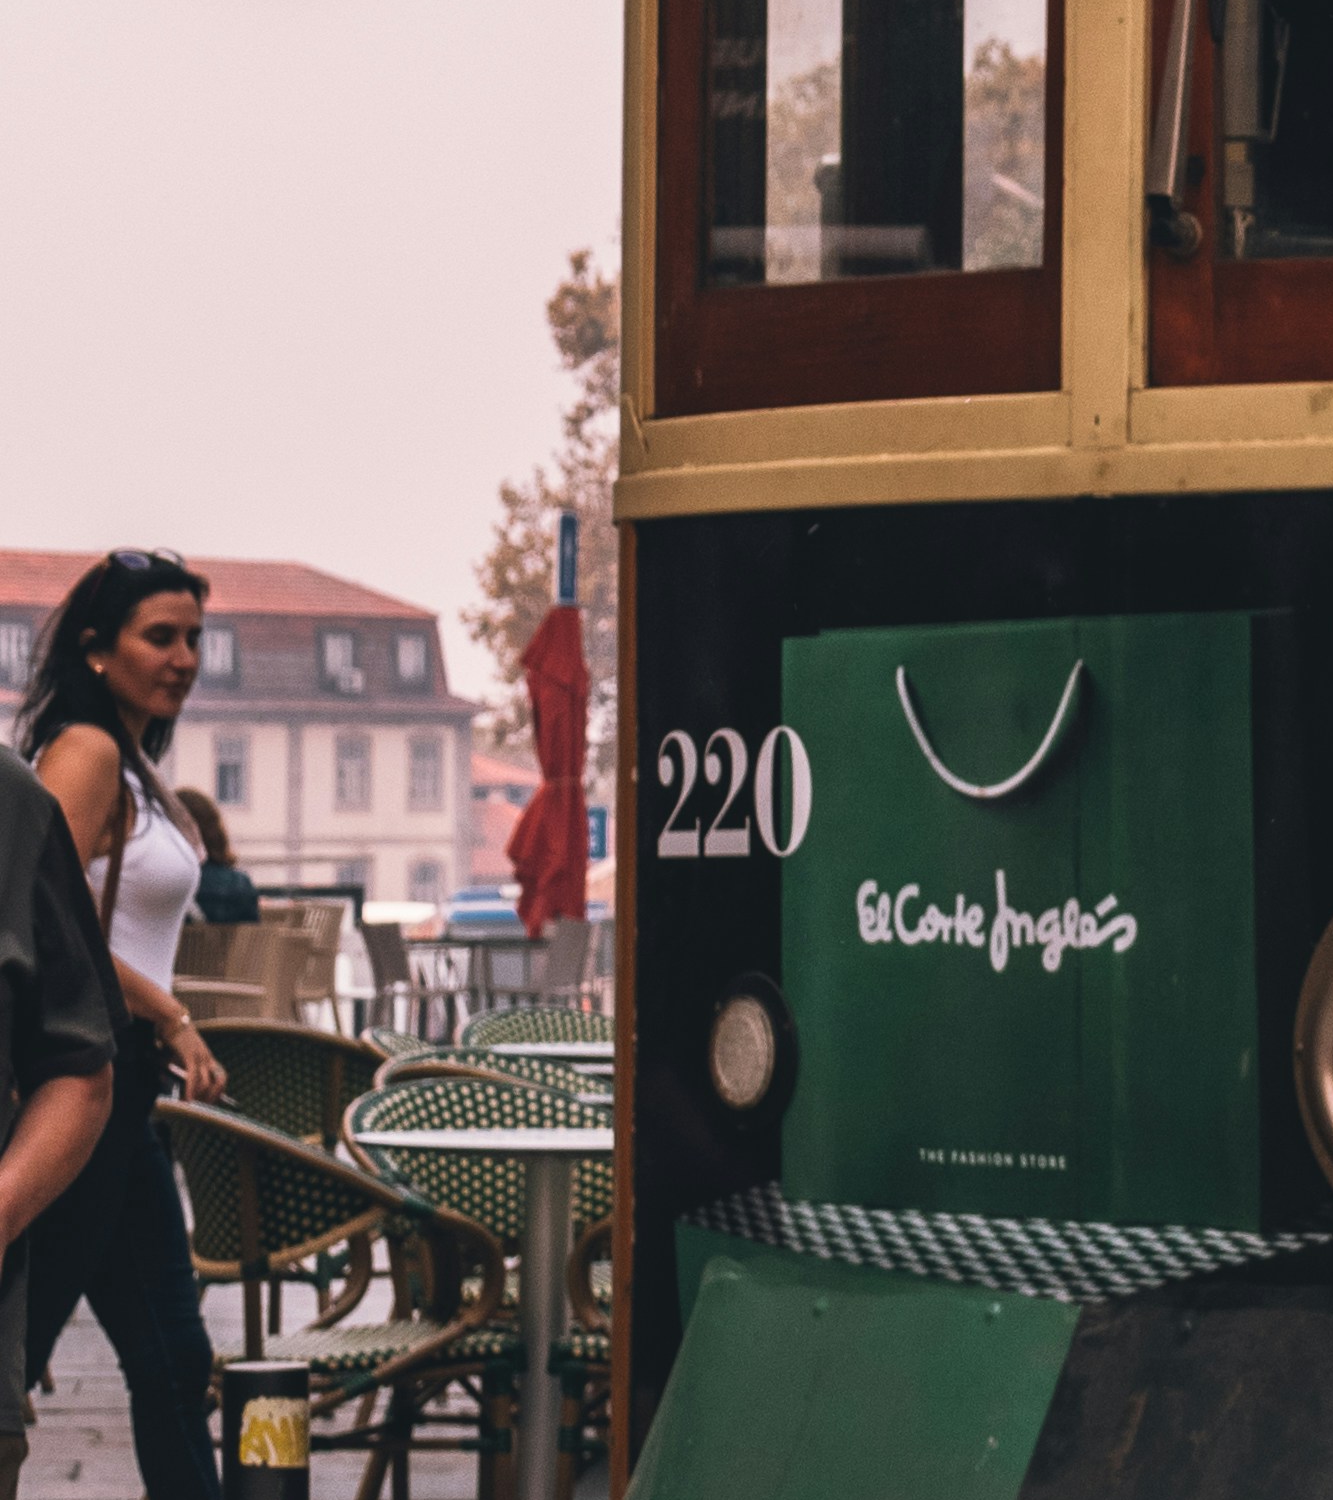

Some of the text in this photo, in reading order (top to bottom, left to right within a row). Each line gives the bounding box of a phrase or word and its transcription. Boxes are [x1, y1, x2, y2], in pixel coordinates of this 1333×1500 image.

[657, 724, 813, 858] 220
[856, 879, 894, 944] El
[893, 882, 986, 949] Corte
[919, 1147, 1068, 1171] THE FASHION STORE
